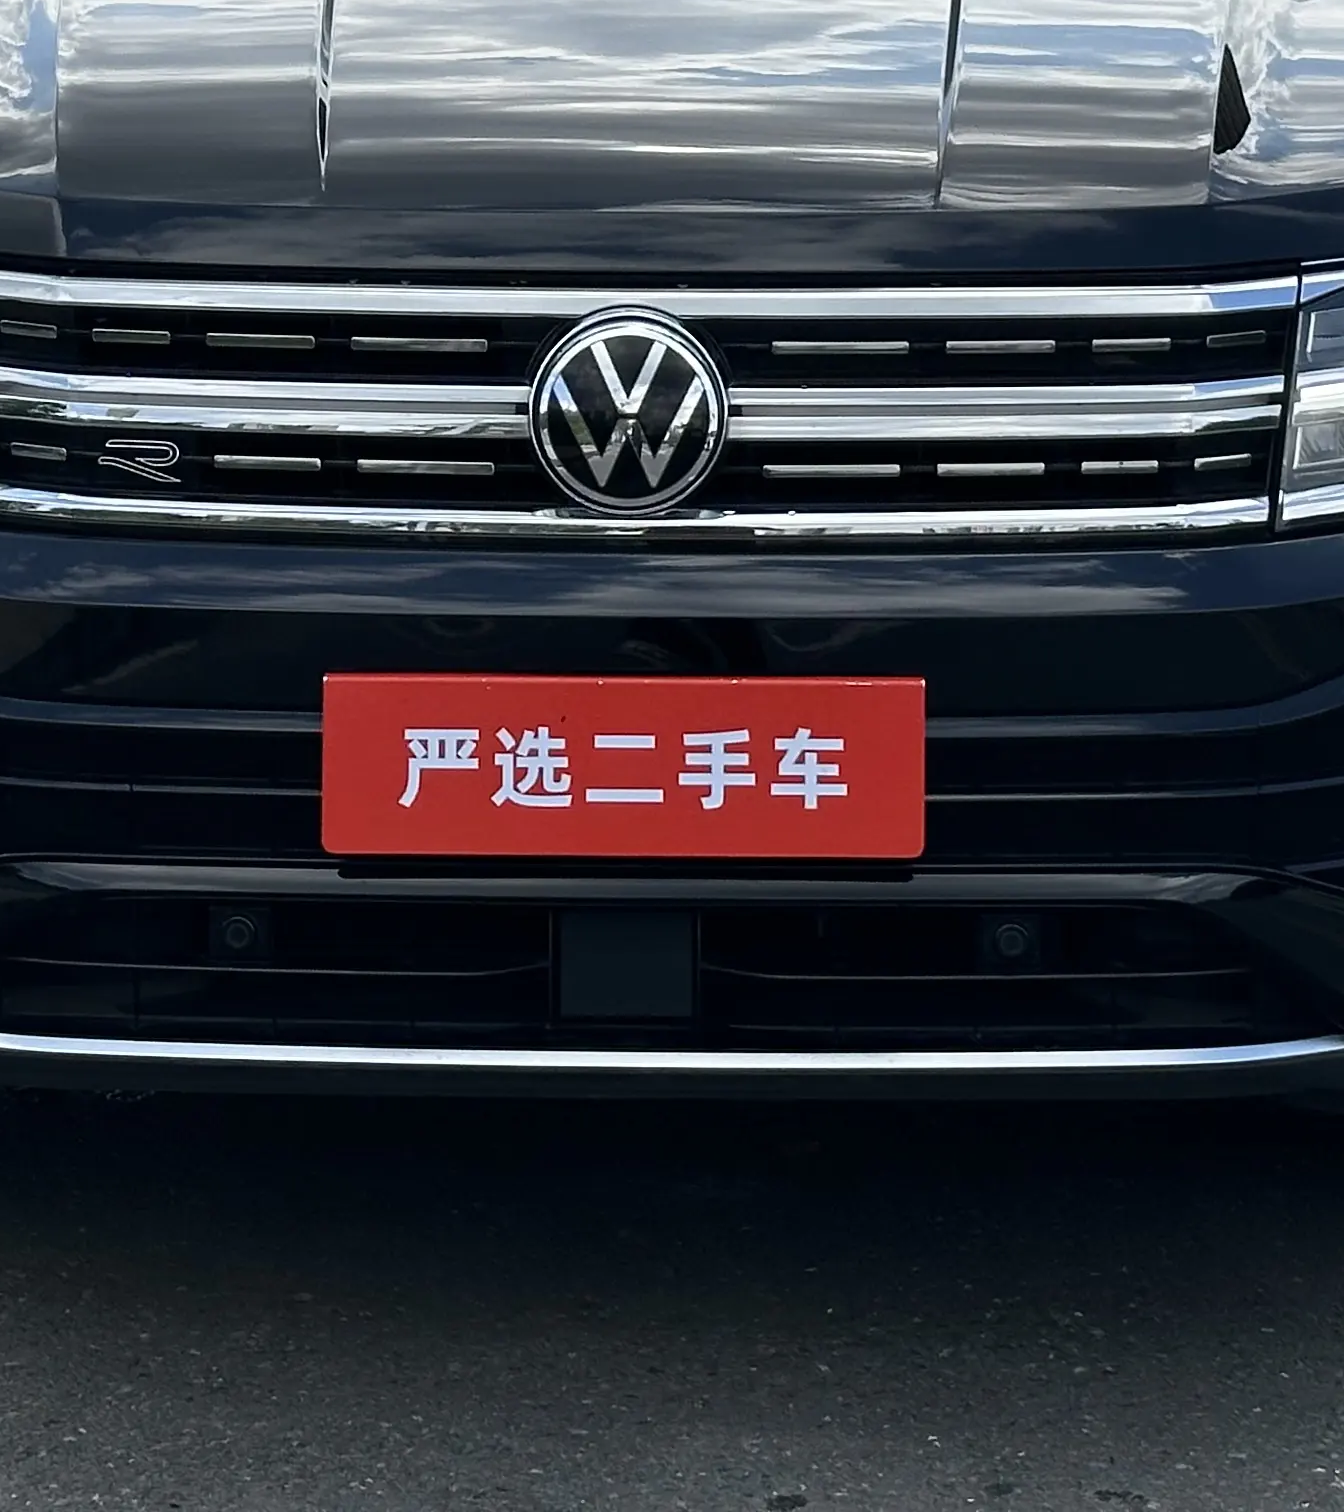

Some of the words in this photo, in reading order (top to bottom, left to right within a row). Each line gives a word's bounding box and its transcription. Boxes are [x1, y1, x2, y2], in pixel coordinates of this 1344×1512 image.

[98, 439, 181, 482] R
[397, 726, 849, 810] 严选二手车
